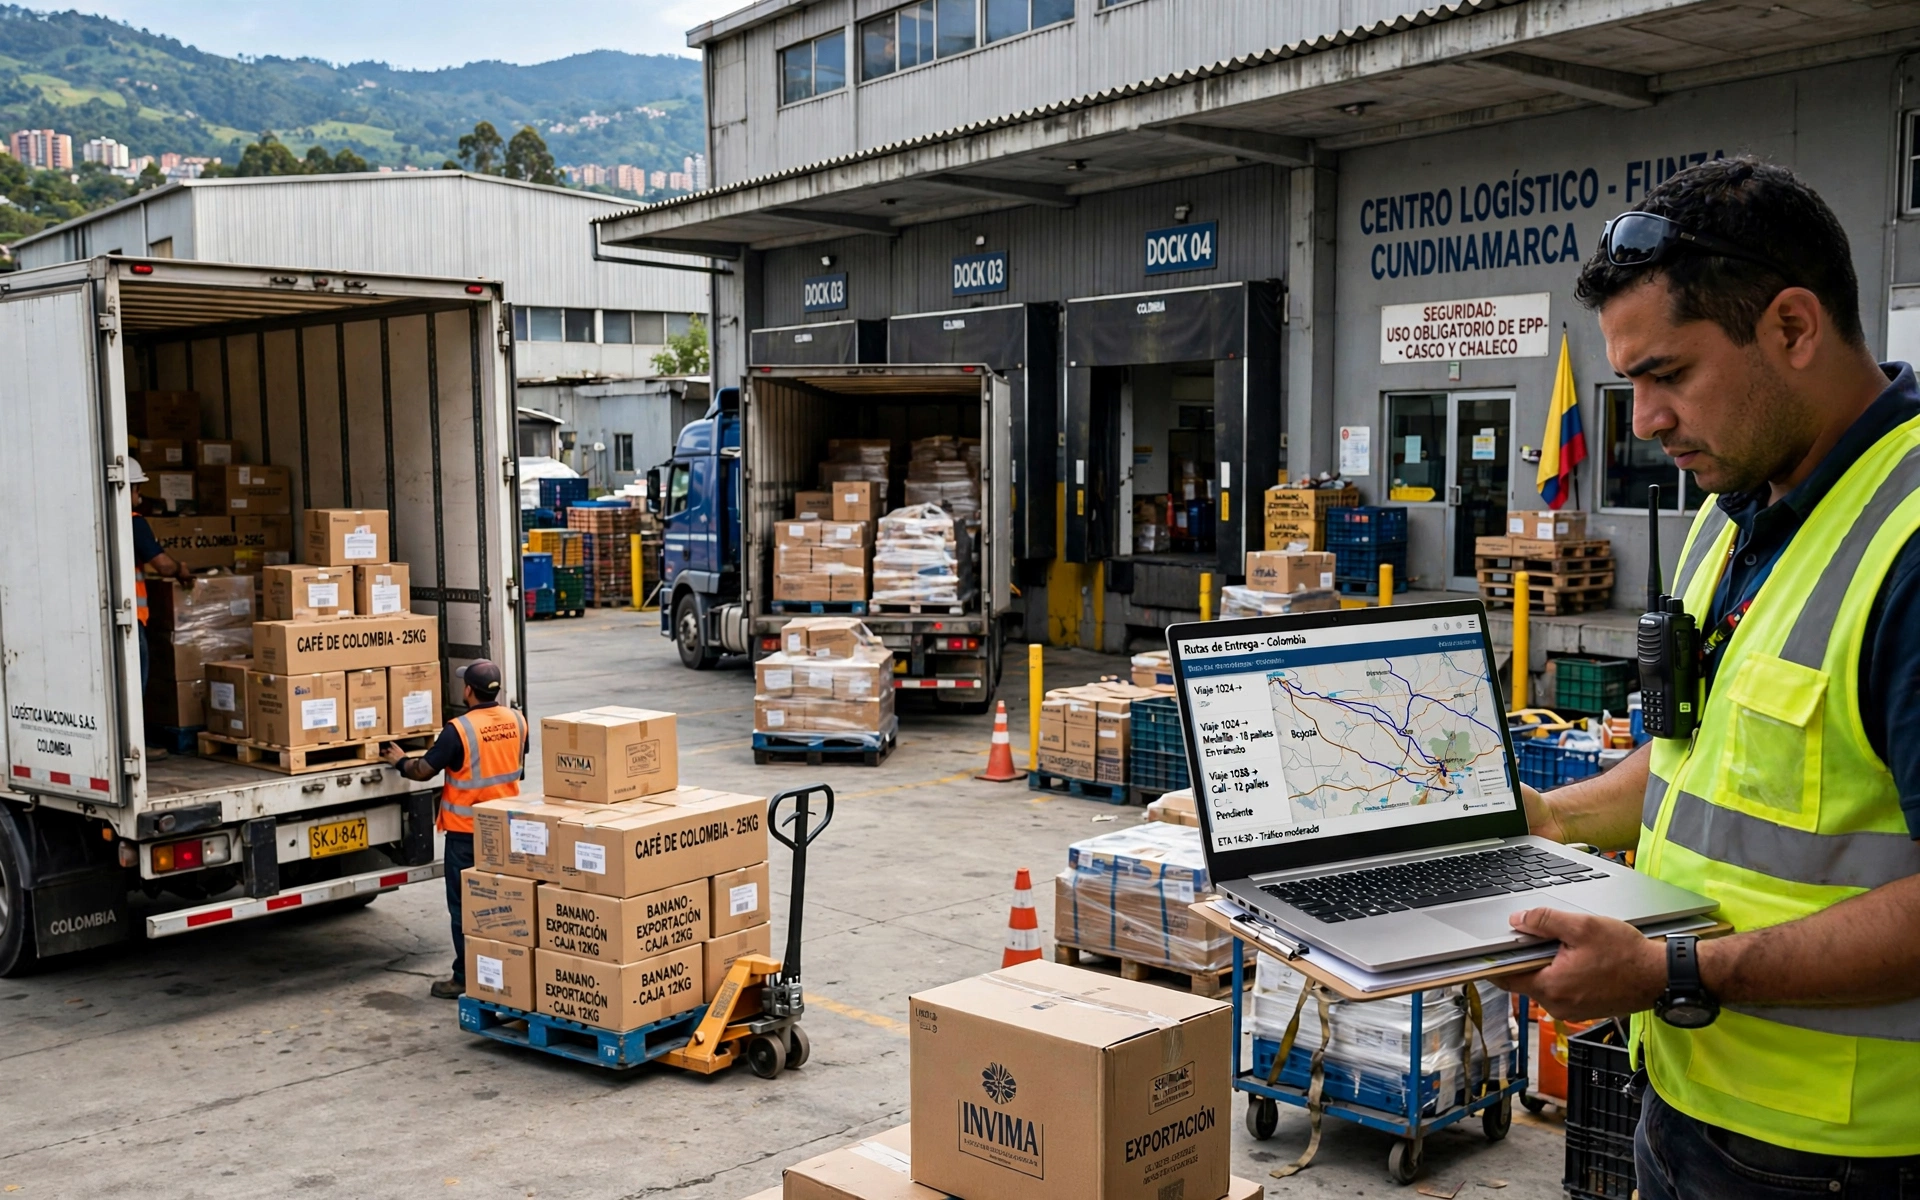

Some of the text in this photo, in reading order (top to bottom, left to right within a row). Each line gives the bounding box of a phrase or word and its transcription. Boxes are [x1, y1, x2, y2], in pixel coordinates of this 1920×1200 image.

[1360, 188, 1450, 235] CENTRO
[1460, 168, 1598, 224] LOGÍSTICO
[1147, 231, 1211, 266] DOCK 04
[1371, 222, 1580, 281] CUNDINAMARCA
[954, 258, 1003, 288] DOCK 03
[805, 281, 844, 306] DOCK 03
[1424, 301, 1497, 322] SEGURIDAD:
[1387, 327, 1410, 342] USO
[1414, 321, 1494, 341] OBLIGATORIO
[1498, 319, 1515, 335] DE
[1405, 338, 1518, 359] CASCO Y CHALECO
[297, 632, 323, 652] CAFÉ
[327, 635, 340, 650] DE
[342, 631, 394, 649] COLOMBIA
[402, 629, 427, 644] 25KG
[1184, 644, 1209, 655] Rutas
[1211, 642, 1222, 652] de
[1225, 640, 1259, 652] Entrega
[1267, 635, 1306, 647] Colombia
[1194, 684, 1235, 697] Viaje 1024
[79, 714, 97, 731] S.A.S.
[1234, 782, 1243, 792] 12
[635, 832, 661, 859] CAFÉ
[664, 833, 677, 852] DE
[680, 821, 728, 849] COLOMBIA
[736, 814, 759, 835] 25KG
[1218, 836, 1233, 846] ETA
[50, 909, 117, 936] COLOMBIA
[546, 918, 607, 942] EXPORTACIÓN
[636, 908, 701, 939] EXPORTACIÓN
[554, 936, 576, 951] CAJA
[578, 940, 599, 956] 12KG
[645, 936, 669, 952] CAJA
[671, 927, 693, 944] 12KG
[545, 983, 608, 1009] EXPORTACIÓN
[639, 990, 665, 1006] CAJA
[667, 977, 692, 996] 12KG
[554, 1001, 576, 1016] CAJA
[578, 1007, 599, 1022] 12KG
[963, 1101, 1039, 1157] INVIMA
[1125, 1105, 1215, 1164] EXPORTACIÓN
